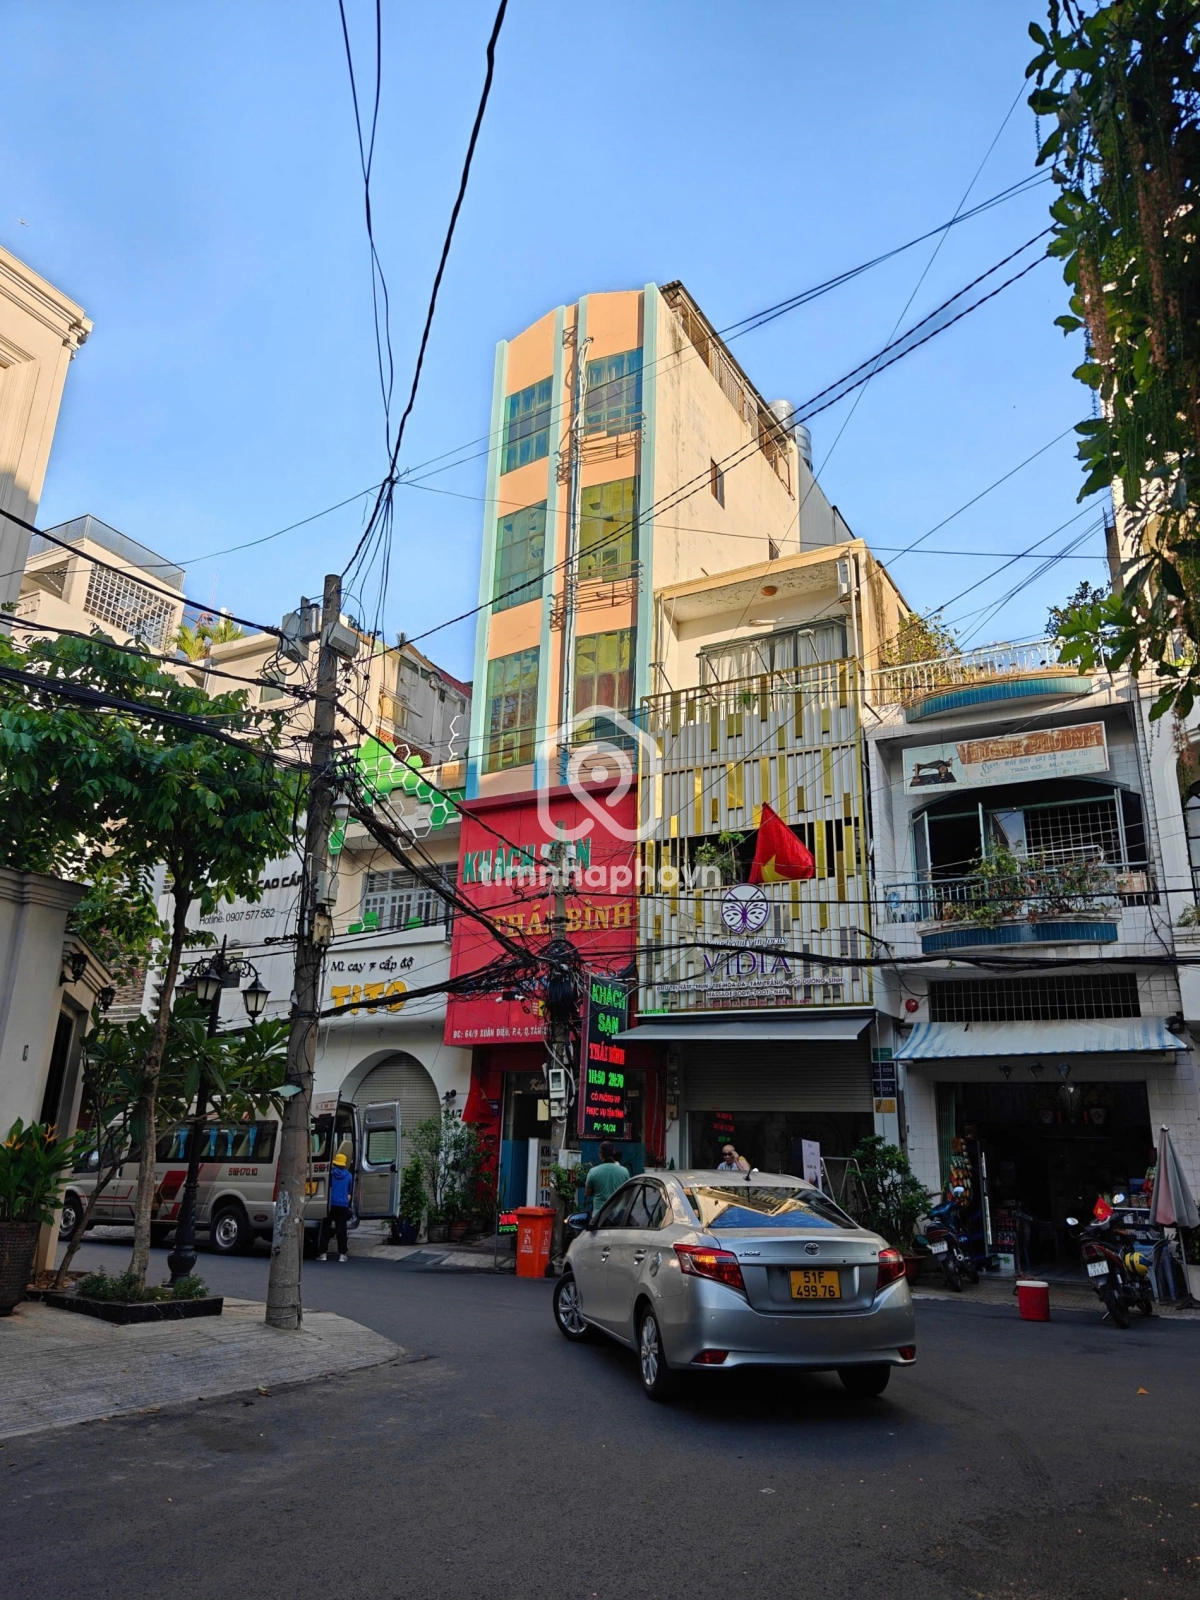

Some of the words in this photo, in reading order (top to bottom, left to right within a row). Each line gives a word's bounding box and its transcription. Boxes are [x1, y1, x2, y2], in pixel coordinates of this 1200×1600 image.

[463, 840, 536, 884] KHÁCH
[226, 912, 244, 923] 0907
[245, 910, 260, 920] 577
[260, 908, 275, 918] 552
[566, 899, 632, 932] BÌNH
[330, 961, 345, 971] Mì
[348, 962, 365, 973] cay
[379, 955, 397, 972] cấp
[400, 957, 414, 970] độ
[703, 951, 792, 976] VIDIA
[331, 981, 407, 1015] TITO
[591, 983, 626, 1010] KHÁCH
[706, 990, 732, 998] MASSAGE
[598, 1012, 619, 1036] SẠN
[803, 1271, 824, 1284] 51F
[796, 1285, 835, 1297] 499.76
